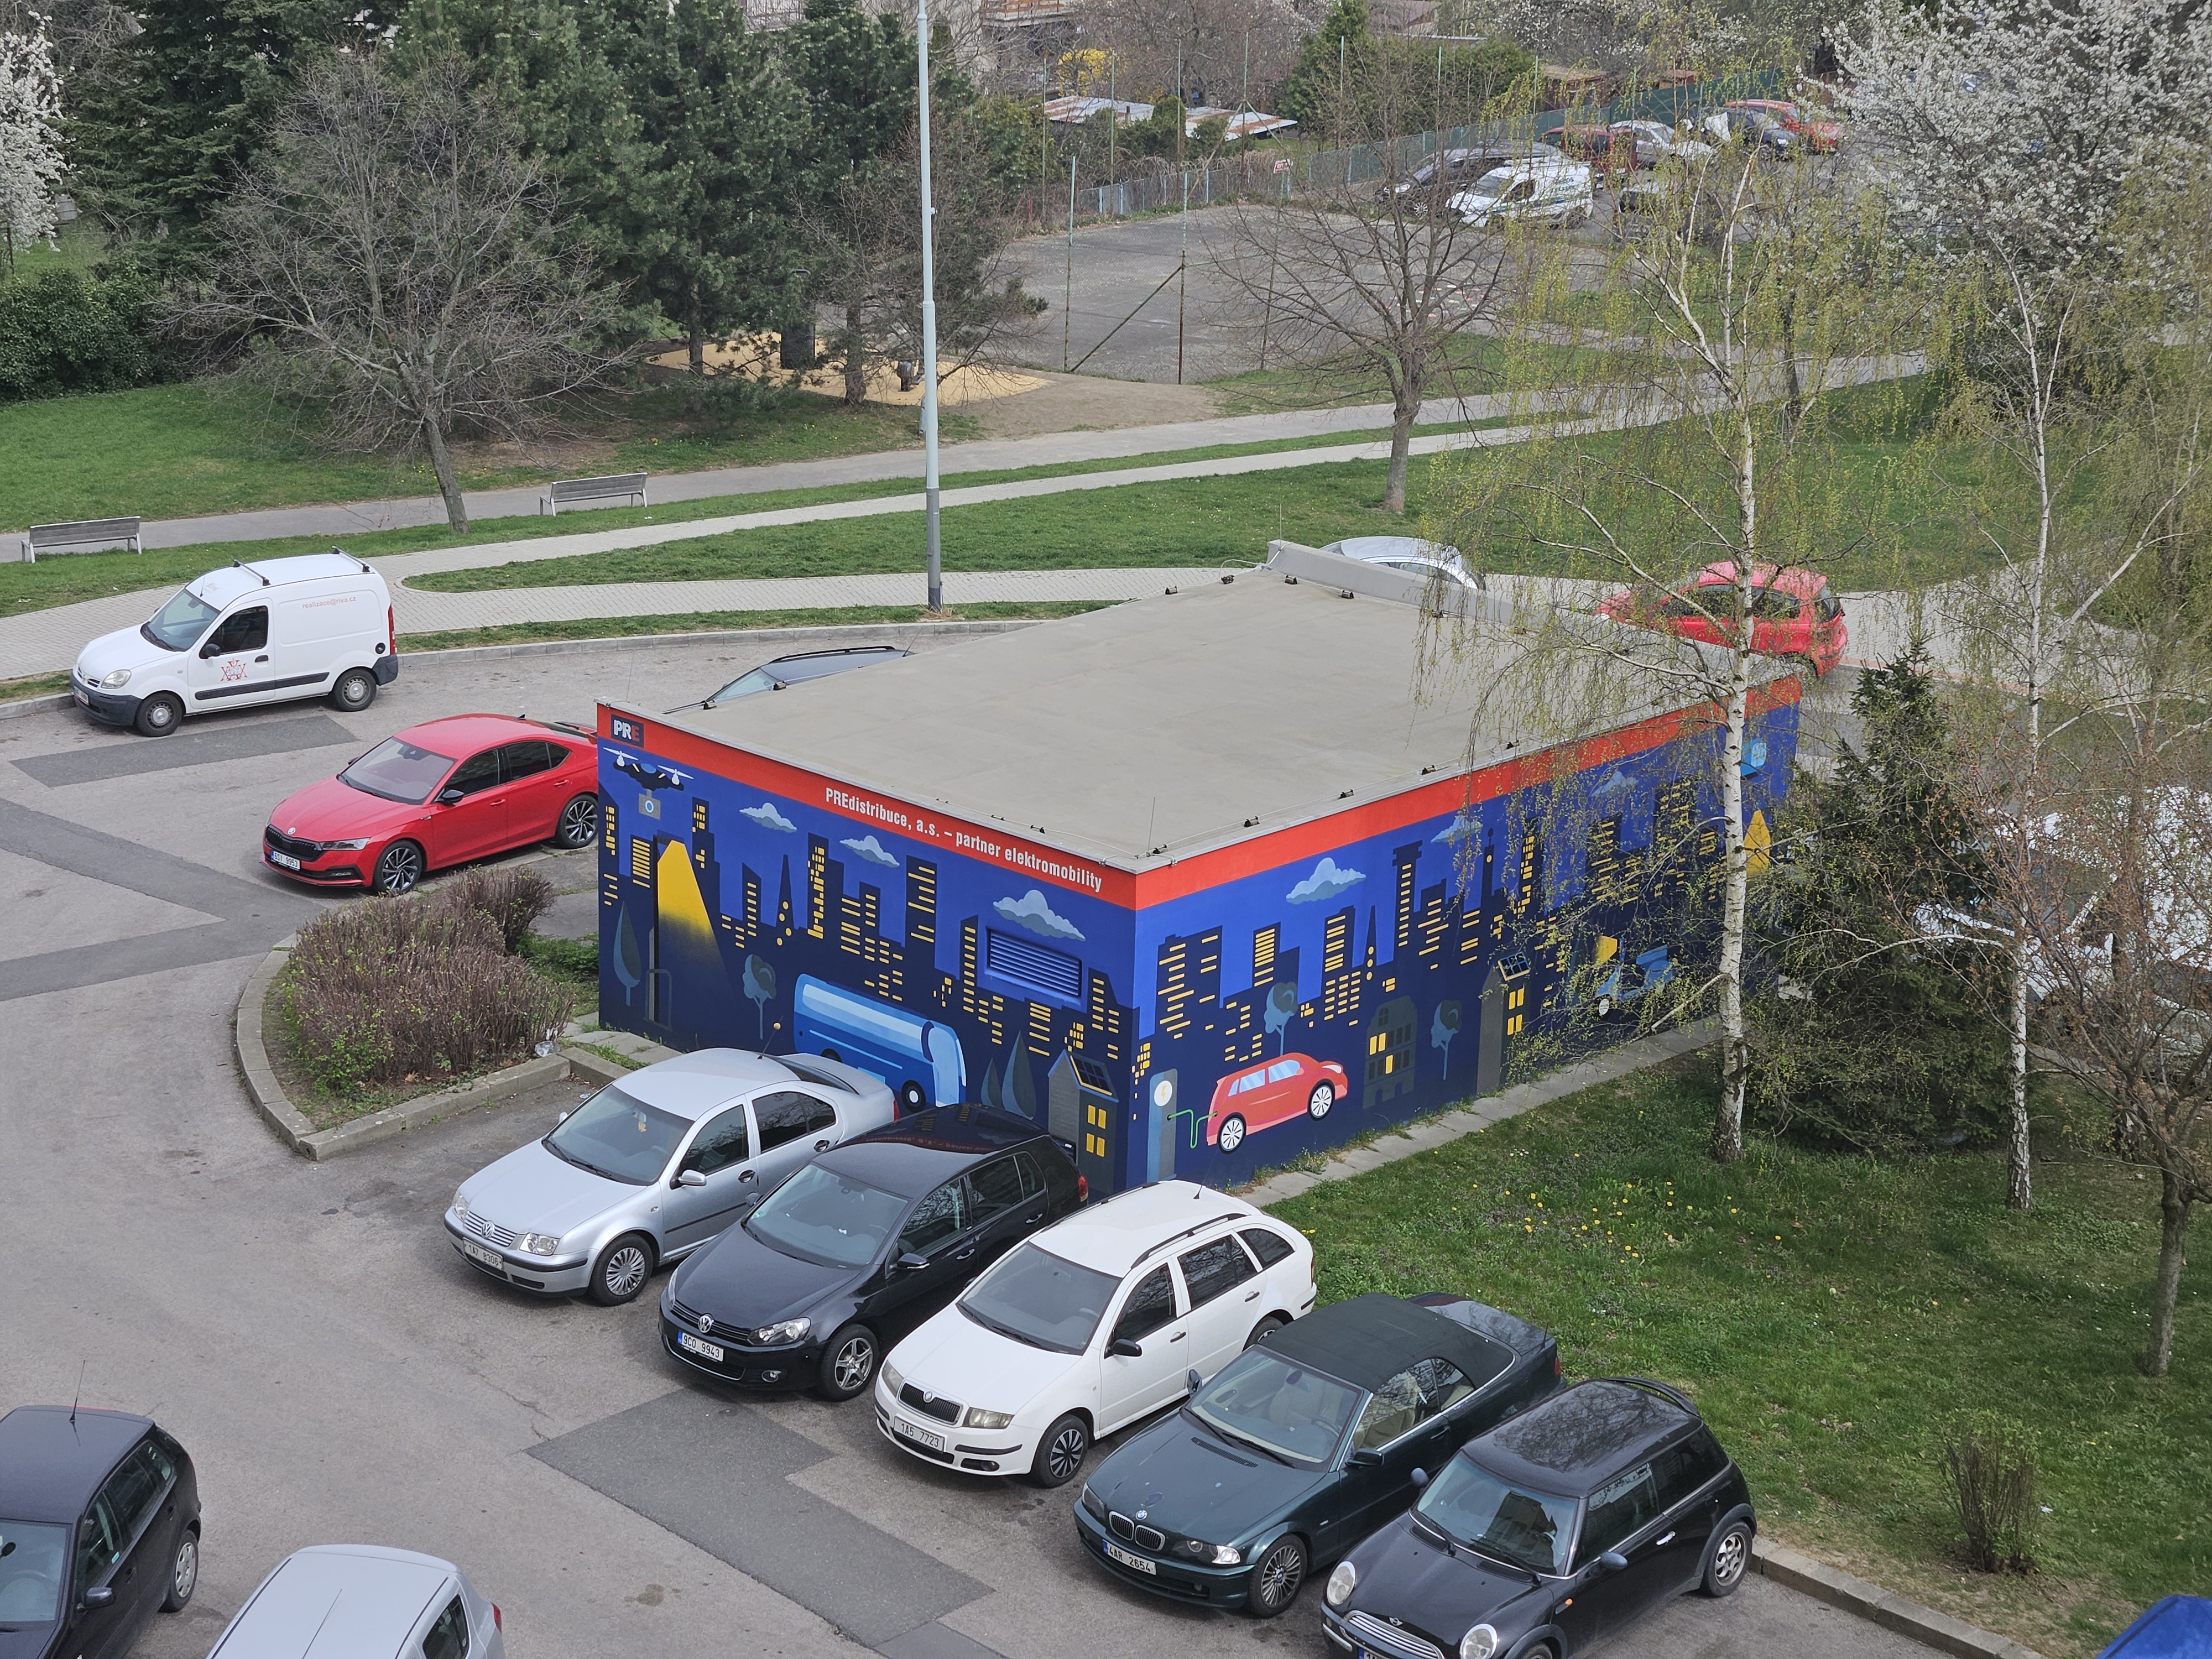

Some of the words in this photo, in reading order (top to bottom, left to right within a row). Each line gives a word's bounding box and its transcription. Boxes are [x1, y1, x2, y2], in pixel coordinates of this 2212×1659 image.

[302, 597, 357, 609] realizace@riva.cz
[614, 719, 640, 742] PRE
[826, 787, 912, 831] PREdistribuce,
[916, 820, 940, 837] a.s.
[956, 831, 1001, 858] partner
[1005, 847, 1102, 893] elektromobility
[701, 1343, 720, 1358] 9943
[901, 1423, 914, 1437] 1A5
[920, 1431, 939, 1448] 7723
[1109, 1546, 1123, 1561] 4AR
[1129, 1556, 1151, 1572] 2654
